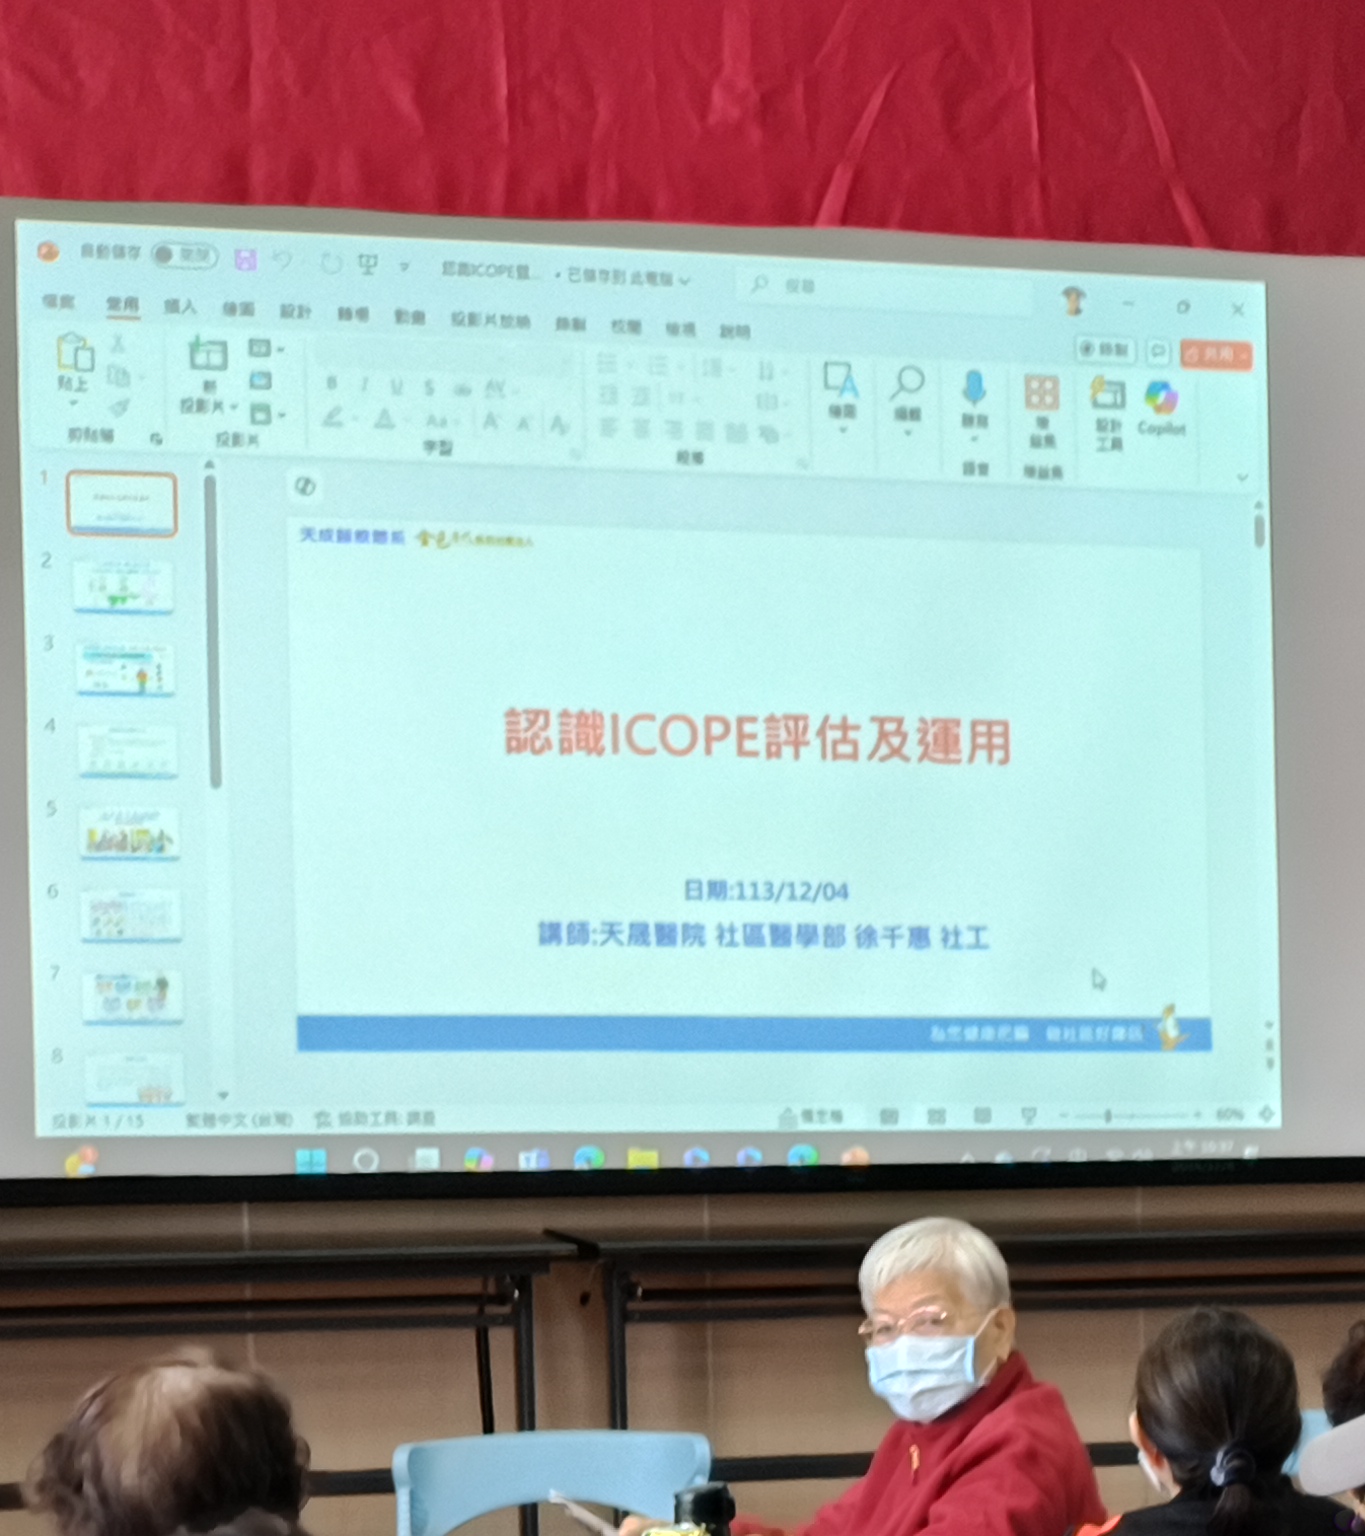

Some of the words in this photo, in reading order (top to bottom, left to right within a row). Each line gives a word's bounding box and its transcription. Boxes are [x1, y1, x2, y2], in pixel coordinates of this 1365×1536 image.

[1138, 421, 1186, 437] Copilot
[41, 551, 52, 569] 2
[44, 634, 54, 652] 3
[44, 717, 56, 734] 4
[503, 707, 1012, 767] 認識ICOPE評估及運用
[47, 800, 57, 817] 5
[47, 884, 58, 899] 6
[684, 879, 850, 902] 日期:113/12/04
[538, 921, 706, 948] 講師:天晟醫院
[716, 922, 847, 950] 社區醫學部
[941, 924, 990, 950] 社工
[50, 964, 60, 980] 7
